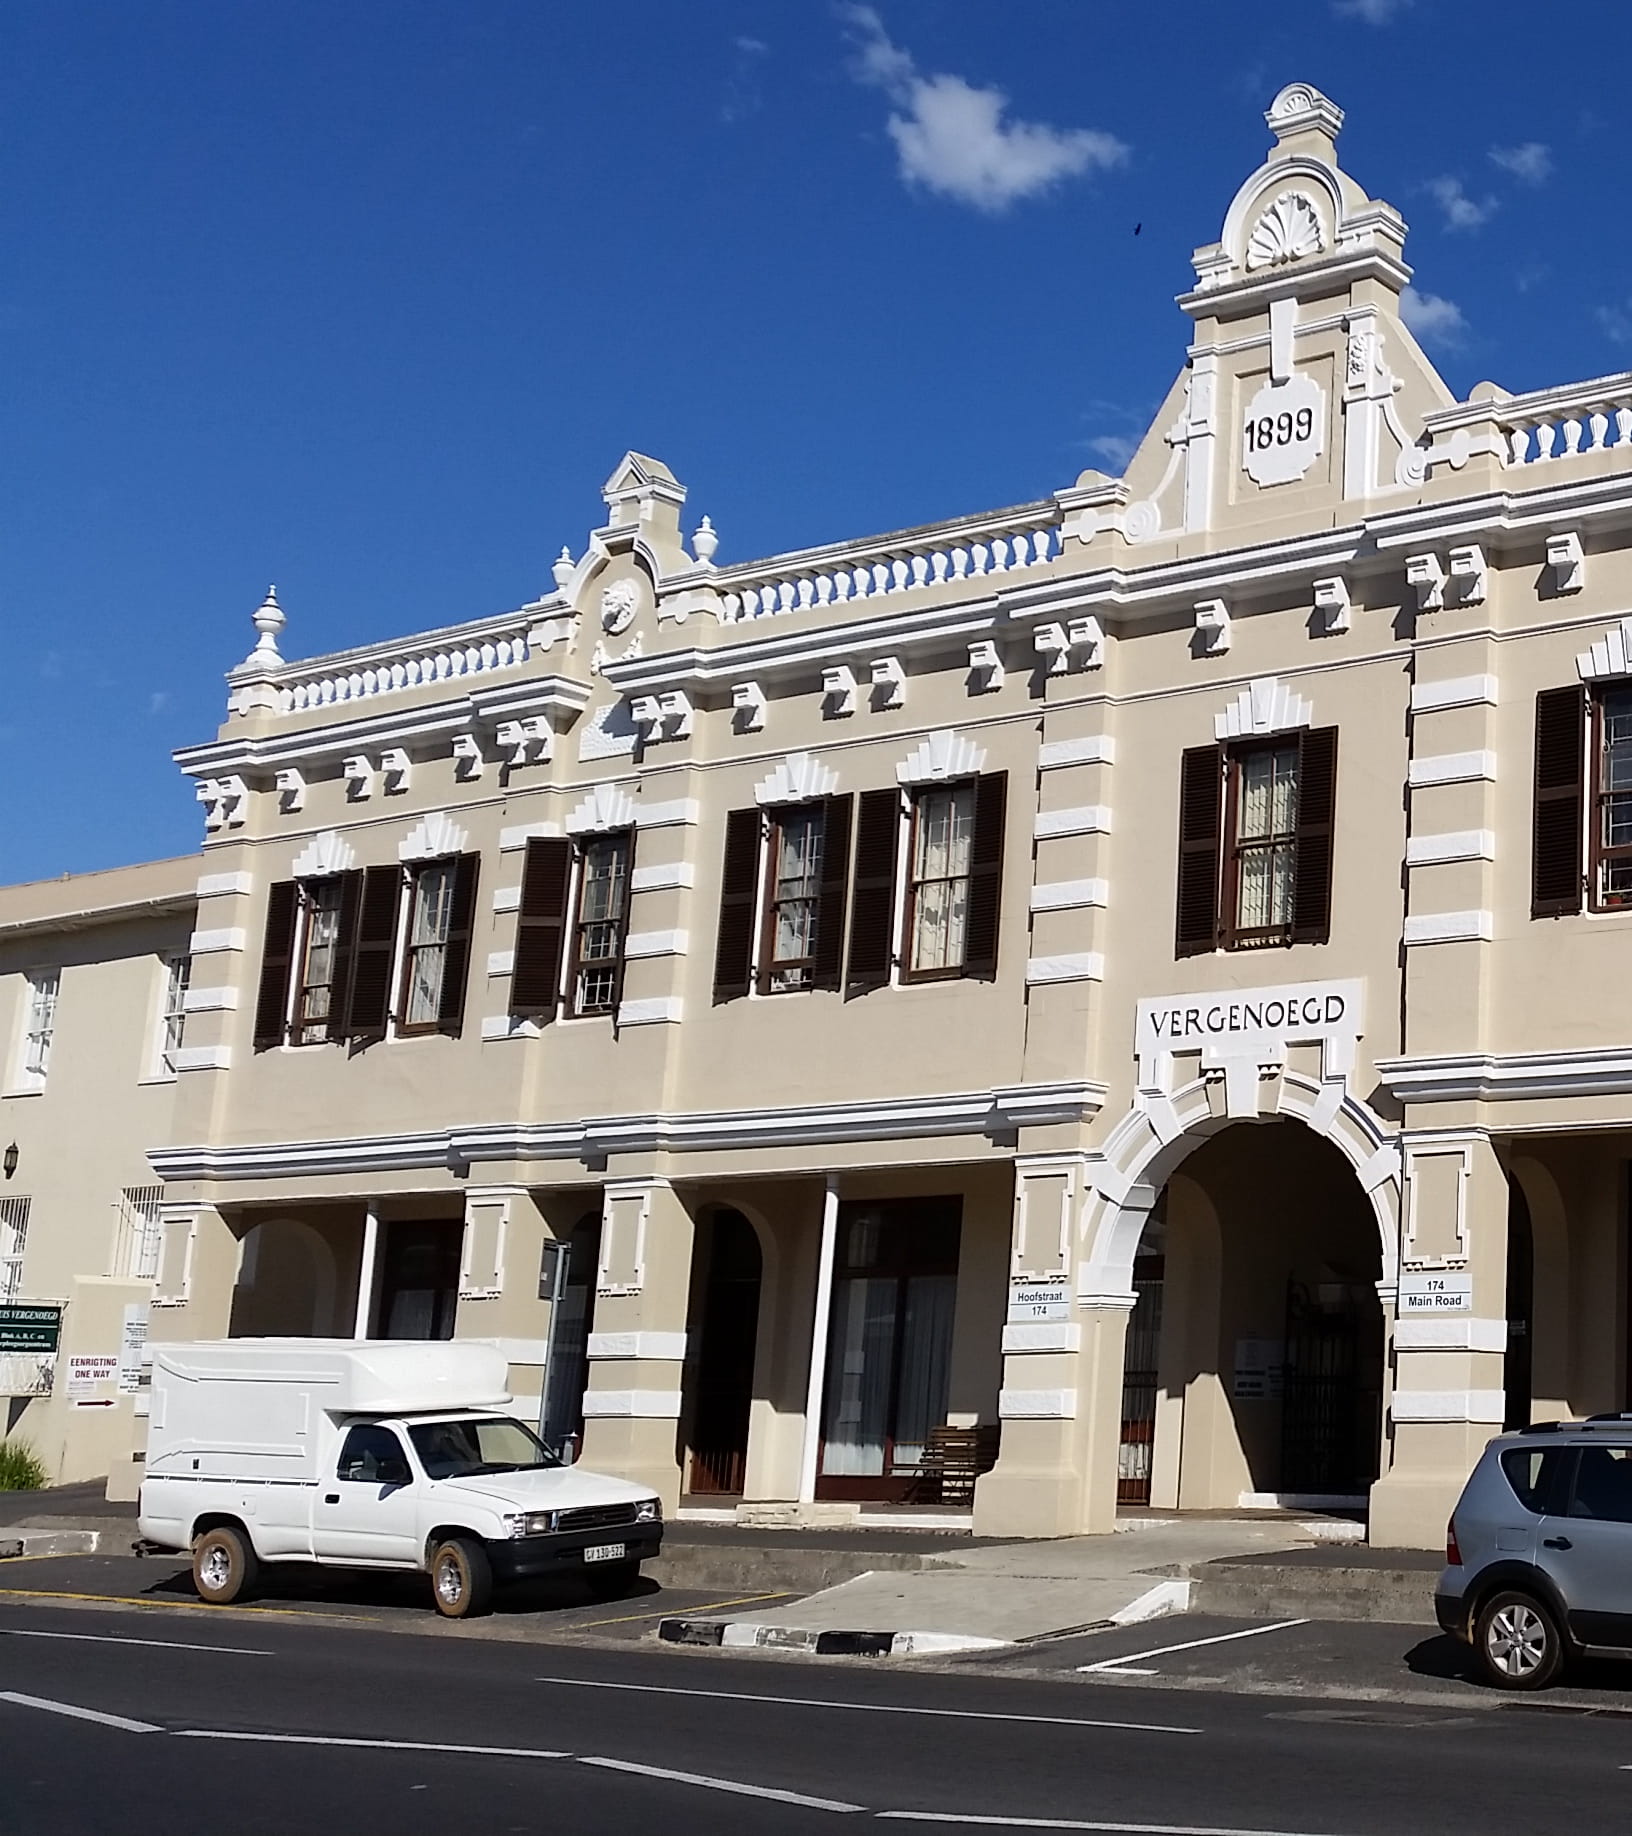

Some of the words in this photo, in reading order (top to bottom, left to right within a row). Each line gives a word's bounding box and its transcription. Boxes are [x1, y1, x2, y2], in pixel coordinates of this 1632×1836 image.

[1244, 407, 1313, 453] 1899
[1150, 994, 1346, 1038] VERGENOEGD
[1427, 1280, 1445, 1291] 174
[1017, 1291, 1063, 1302] Hoofstraat
[1408, 1295, 1432, 1306] Main
[1435, 1295, 1462, 1306] Road
[11, 1310, 58, 1321] VERGENOEGD
[1032, 1305, 1047, 1316] 174
[70, 1358, 117, 1367] EENRIGTING
[75, 1370, 91, 1378] ONE
[93, 1370, 110, 1378] WAY
